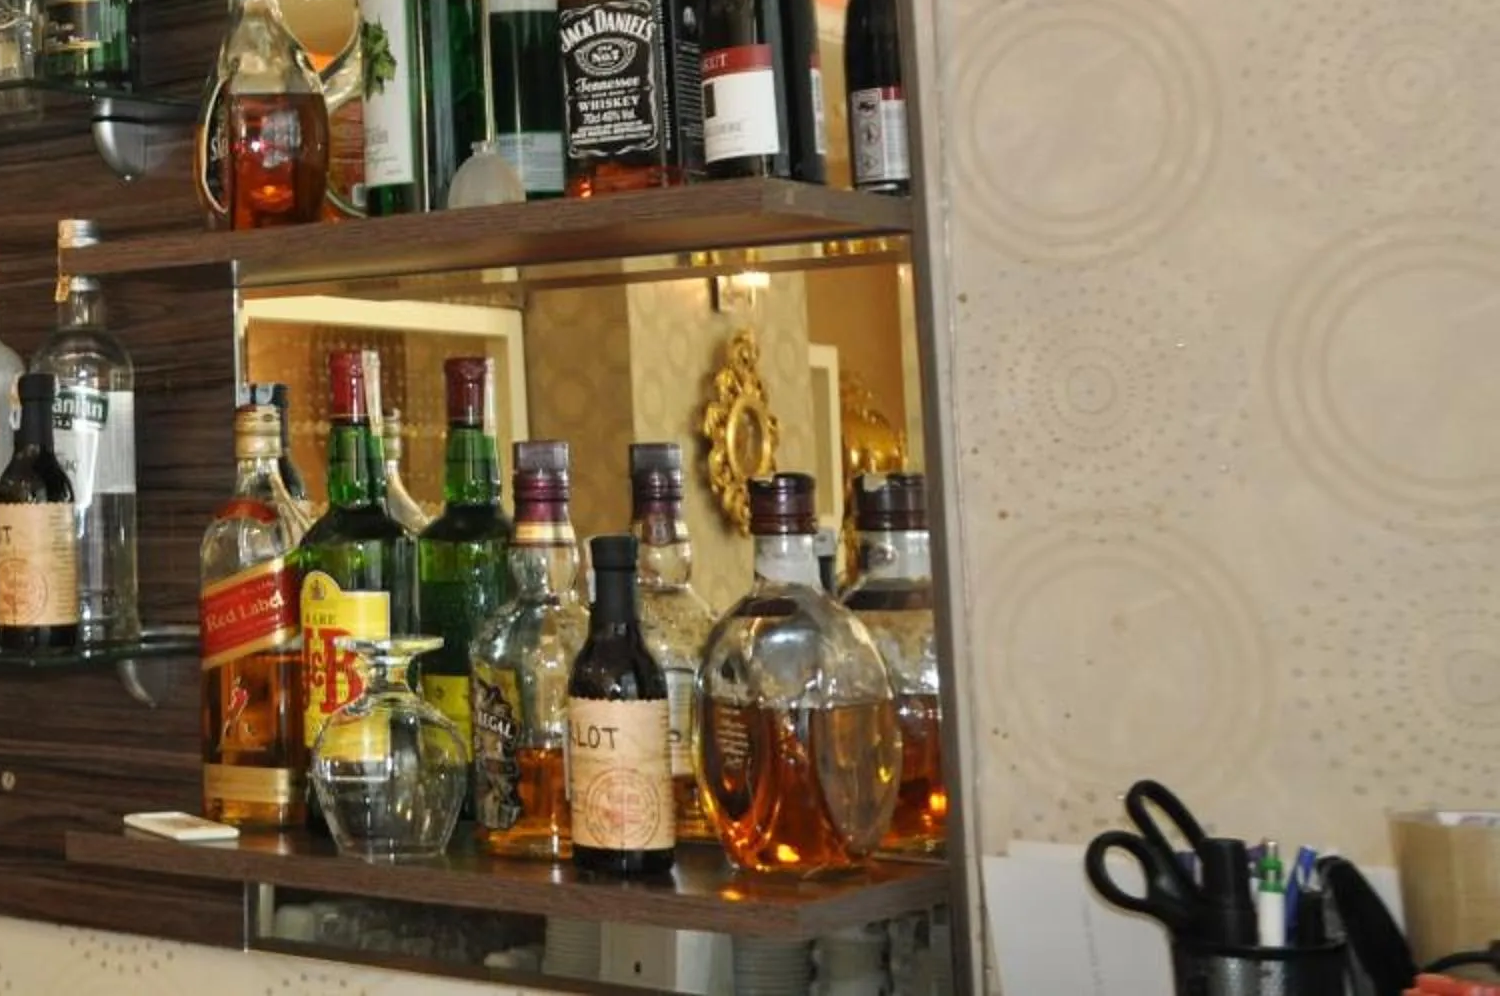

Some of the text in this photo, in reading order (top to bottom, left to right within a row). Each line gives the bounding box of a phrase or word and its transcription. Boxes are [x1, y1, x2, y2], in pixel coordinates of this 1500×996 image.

[560, 8, 656, 53] JACK DANIEL'S
[578, 95, 641, 112] WHISKEY
[204, 589, 285, 632] Red Label
